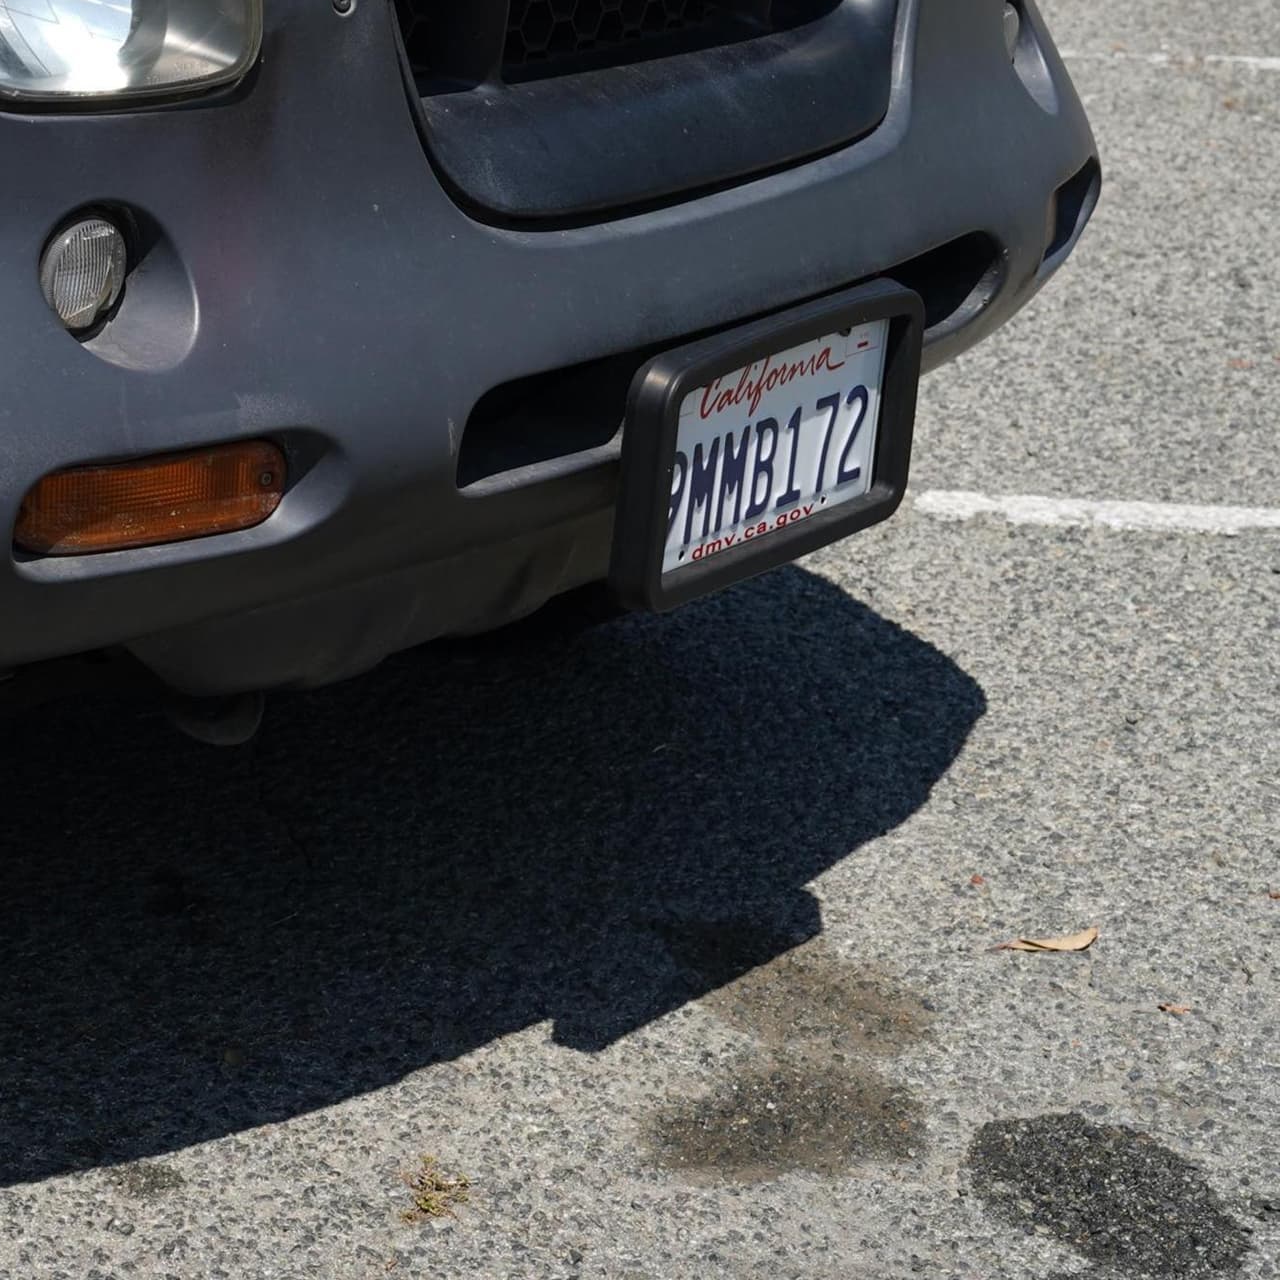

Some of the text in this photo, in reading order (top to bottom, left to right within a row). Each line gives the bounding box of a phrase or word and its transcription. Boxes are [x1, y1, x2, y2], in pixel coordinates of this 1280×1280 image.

[698, 345, 845, 420] California
[665, 384, 869, 547] 9MMB172
[691, 502, 814, 561] dmv.ca.gov
